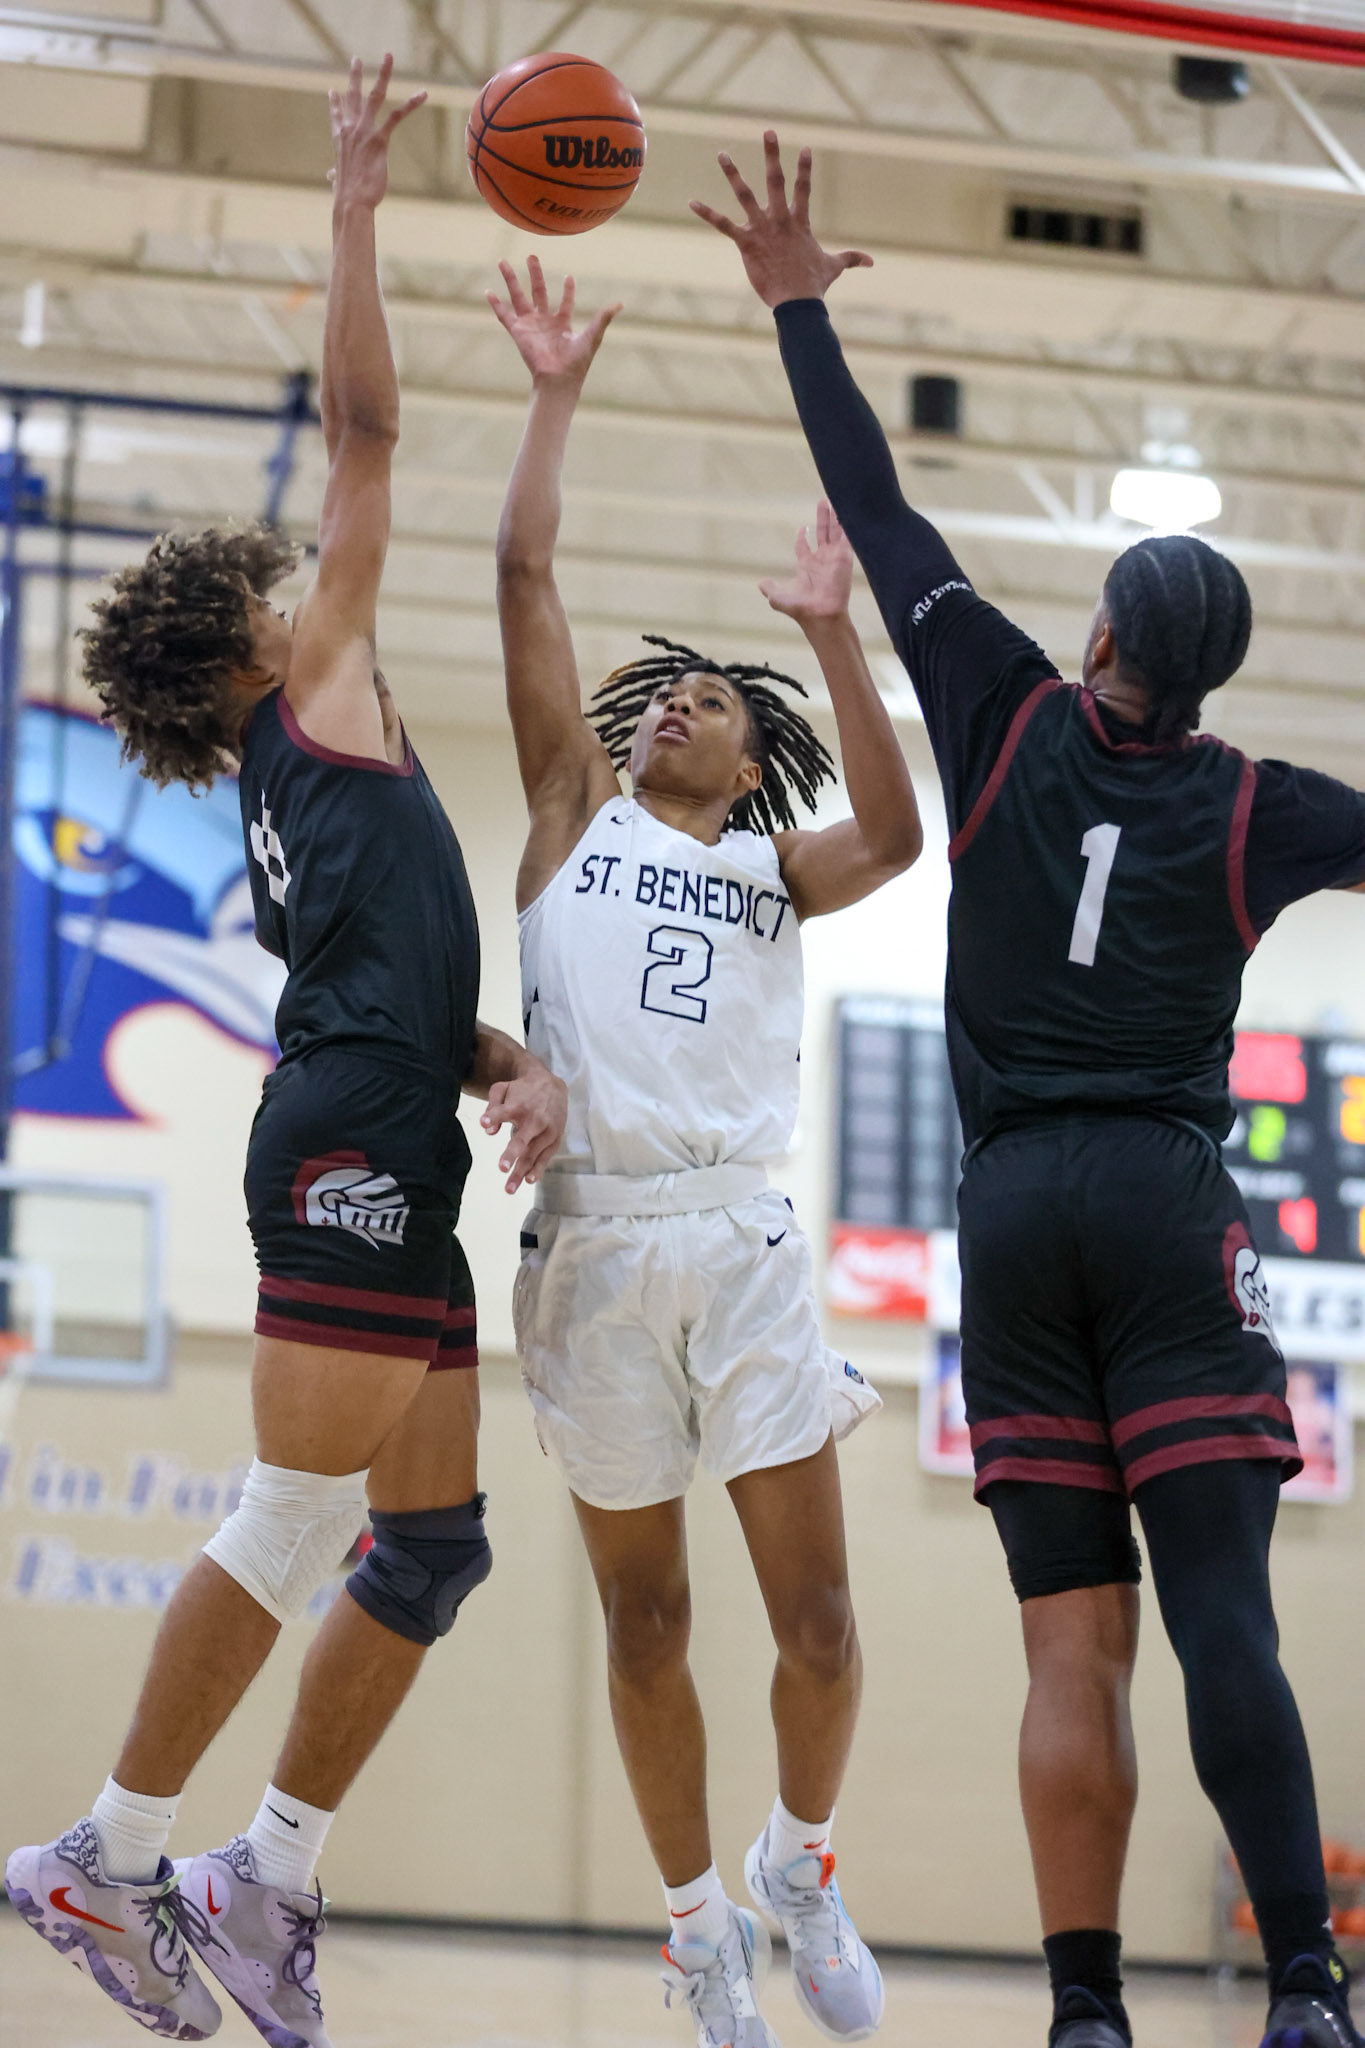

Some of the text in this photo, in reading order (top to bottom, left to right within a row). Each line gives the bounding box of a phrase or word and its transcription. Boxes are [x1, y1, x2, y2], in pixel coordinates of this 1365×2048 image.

[543, 134, 643, 168] Wilson
[575, 854, 791, 942] ST. BENEDICT
[1068, 822, 1122, 967] 1
[640, 924, 714, 1024] 2
